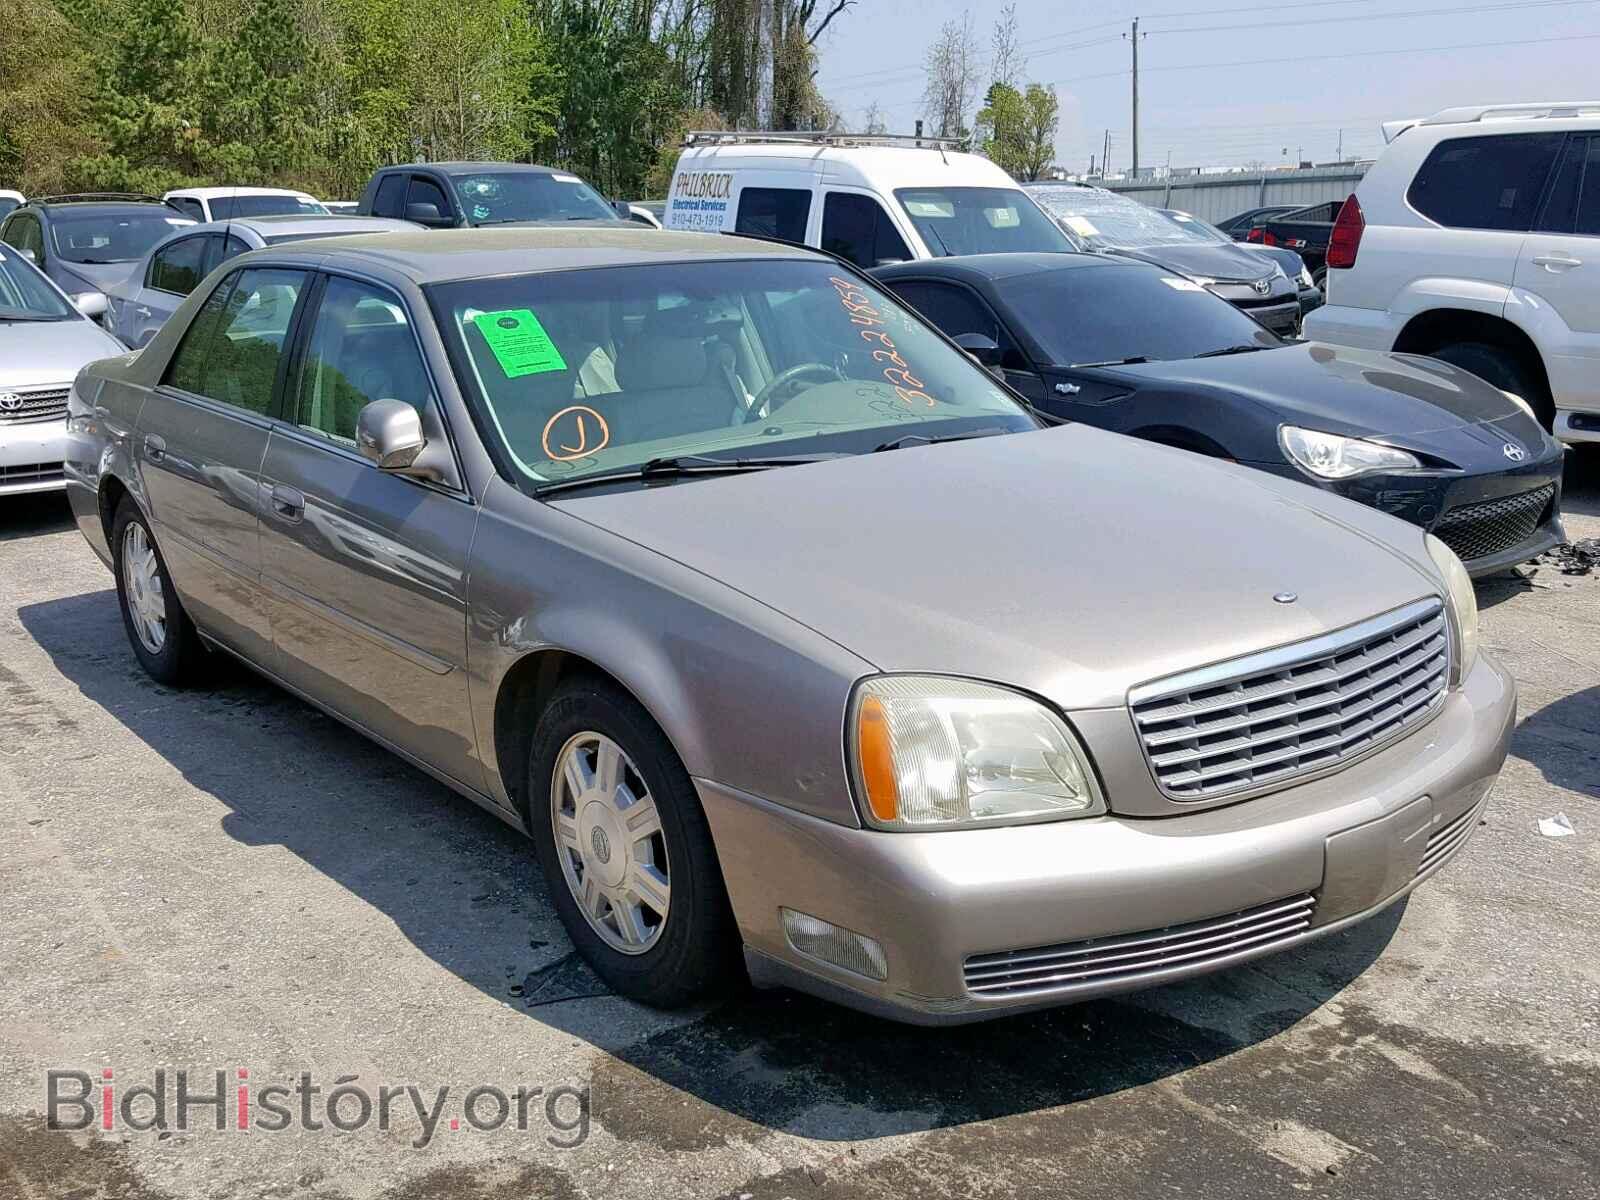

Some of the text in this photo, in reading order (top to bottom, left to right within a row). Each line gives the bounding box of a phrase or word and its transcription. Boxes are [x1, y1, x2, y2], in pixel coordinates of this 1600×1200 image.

[675, 172, 733, 198] PHILBRICK
[673, 199, 727, 211] Electrical Services
[672, 213, 724, 226] 910-473-1919
